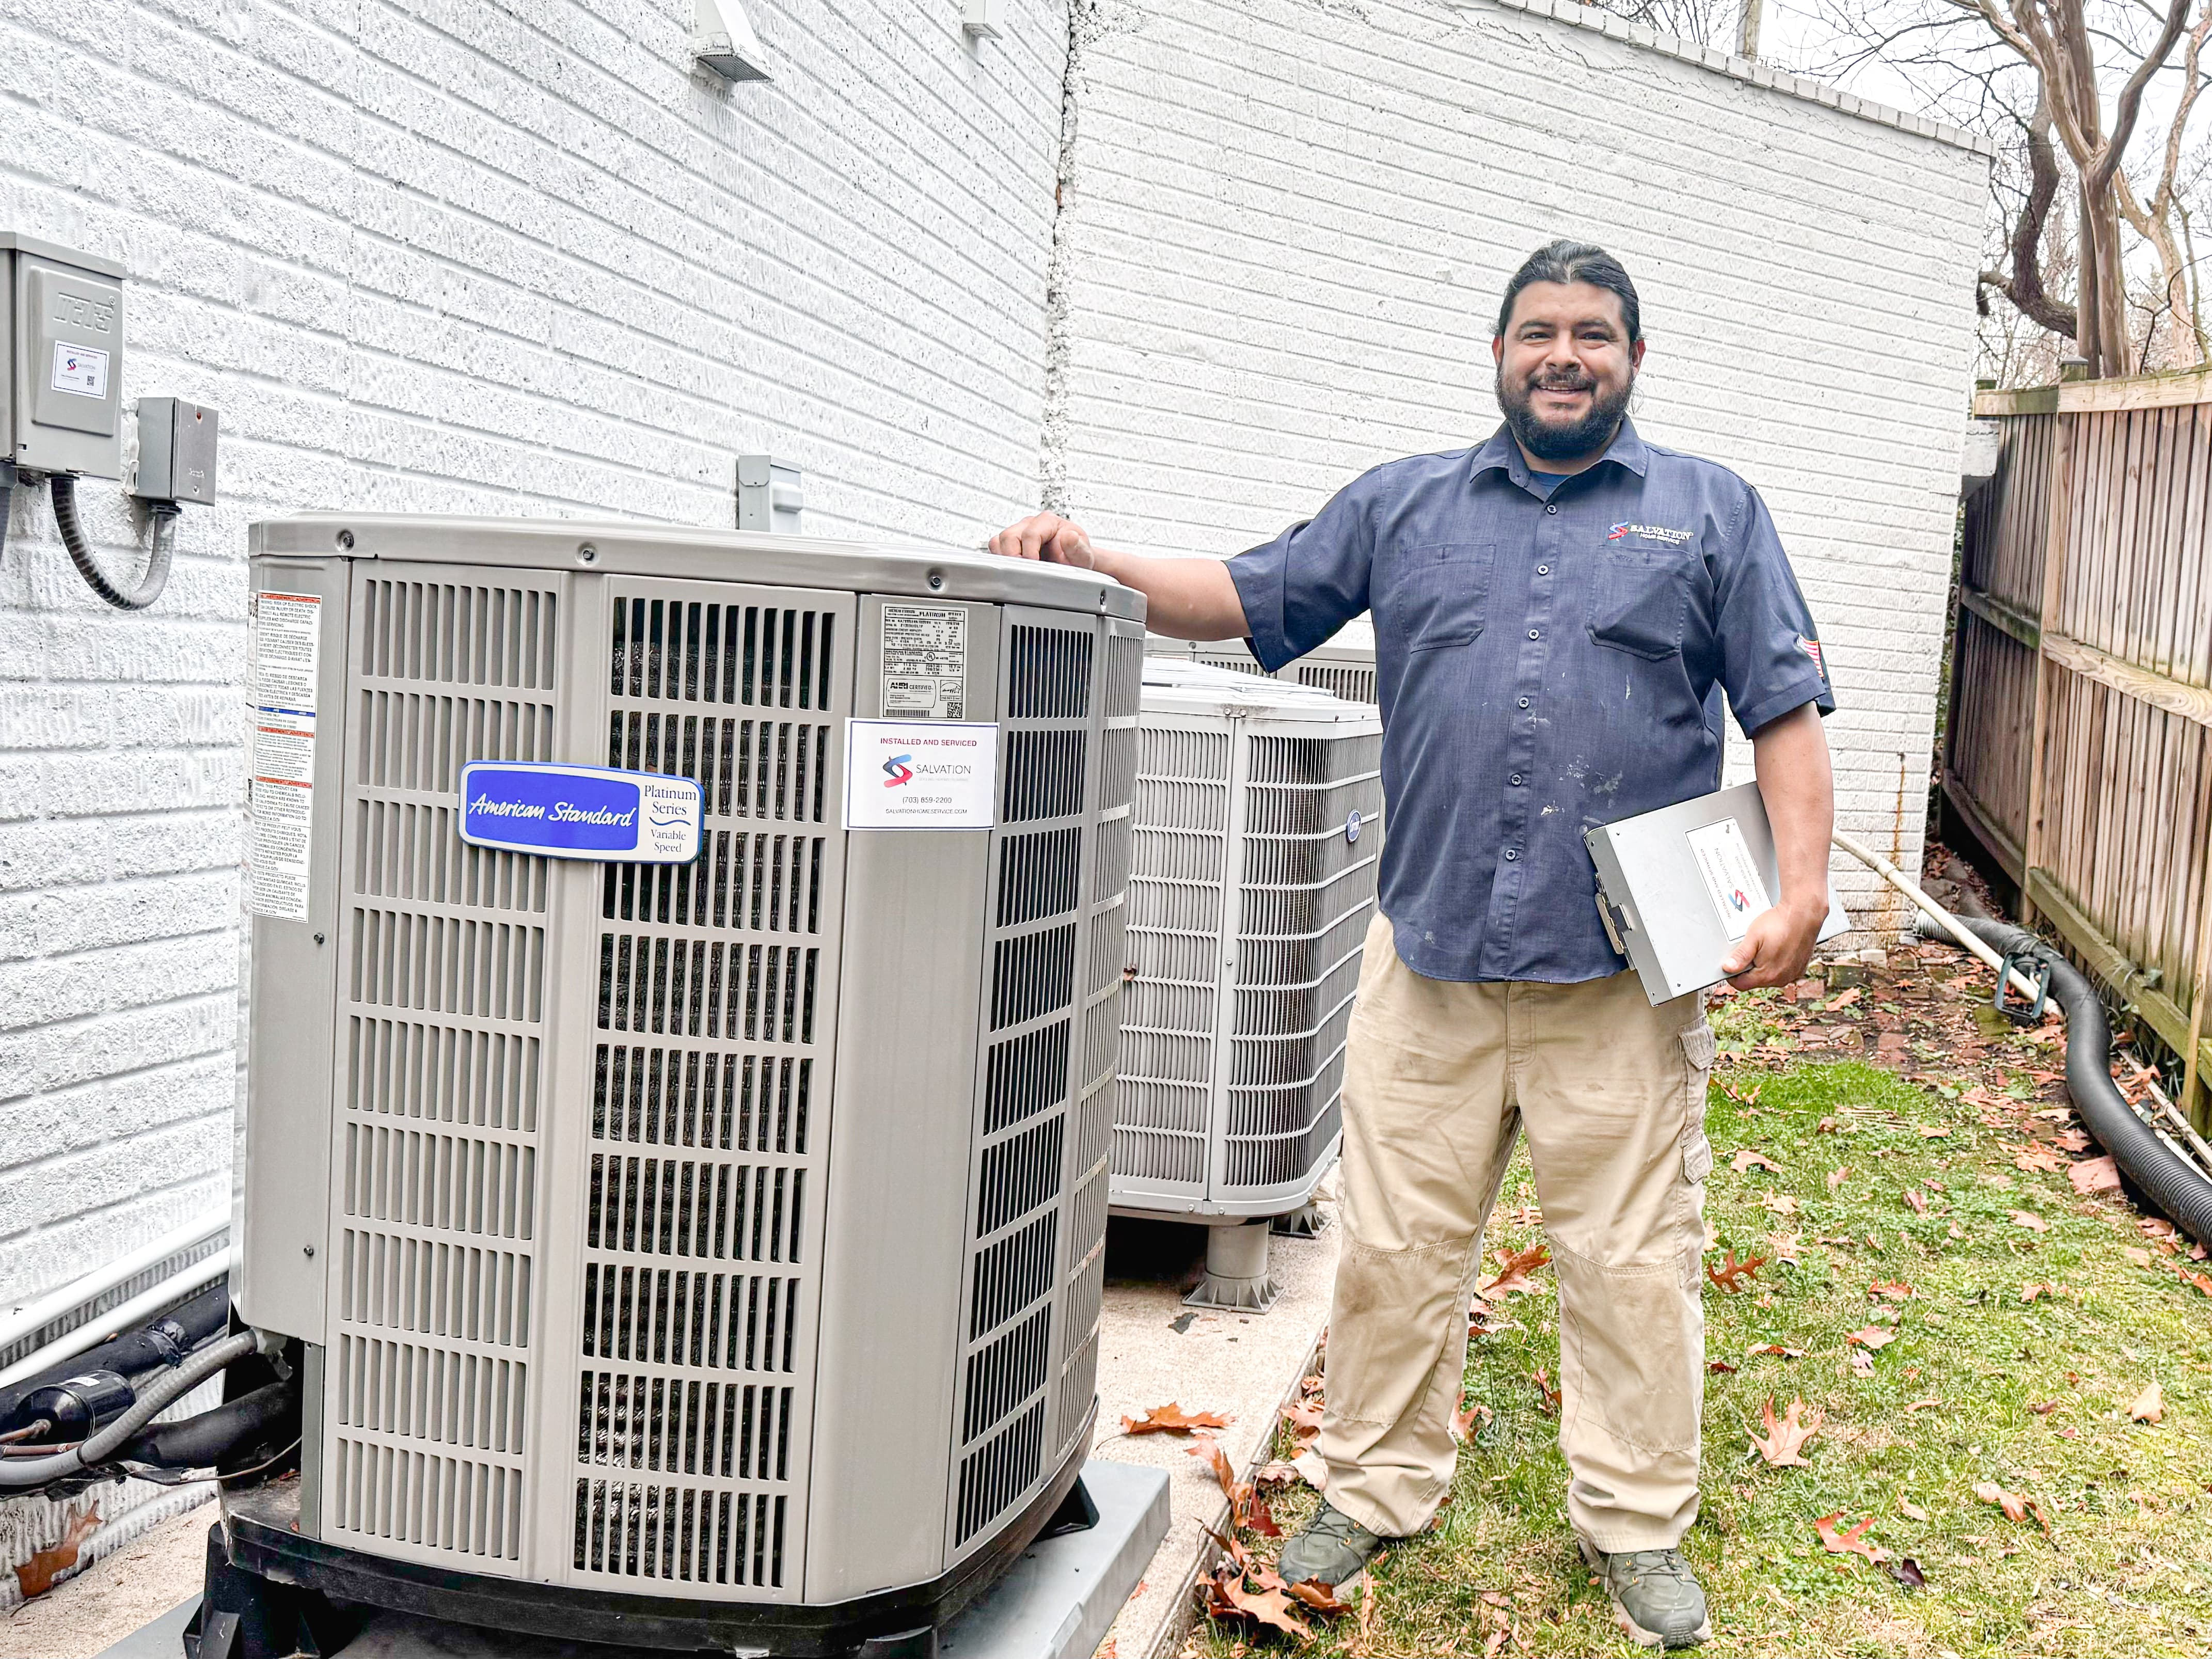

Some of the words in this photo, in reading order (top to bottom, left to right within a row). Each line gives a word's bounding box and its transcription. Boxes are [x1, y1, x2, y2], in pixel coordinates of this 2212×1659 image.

[1630, 525, 1690, 541] SALVATION
[916, 765, 971, 774] SALVATION
[644, 784, 697, 801] Platinum
[469, 792, 545, 820] American
[548, 801, 637, 827] Standard
[652, 801, 687, 816] Series
[650, 828, 687, 841] Variable
[653, 841, 682, 853] Speed
[1714, 846, 1735, 889] SALVATION
